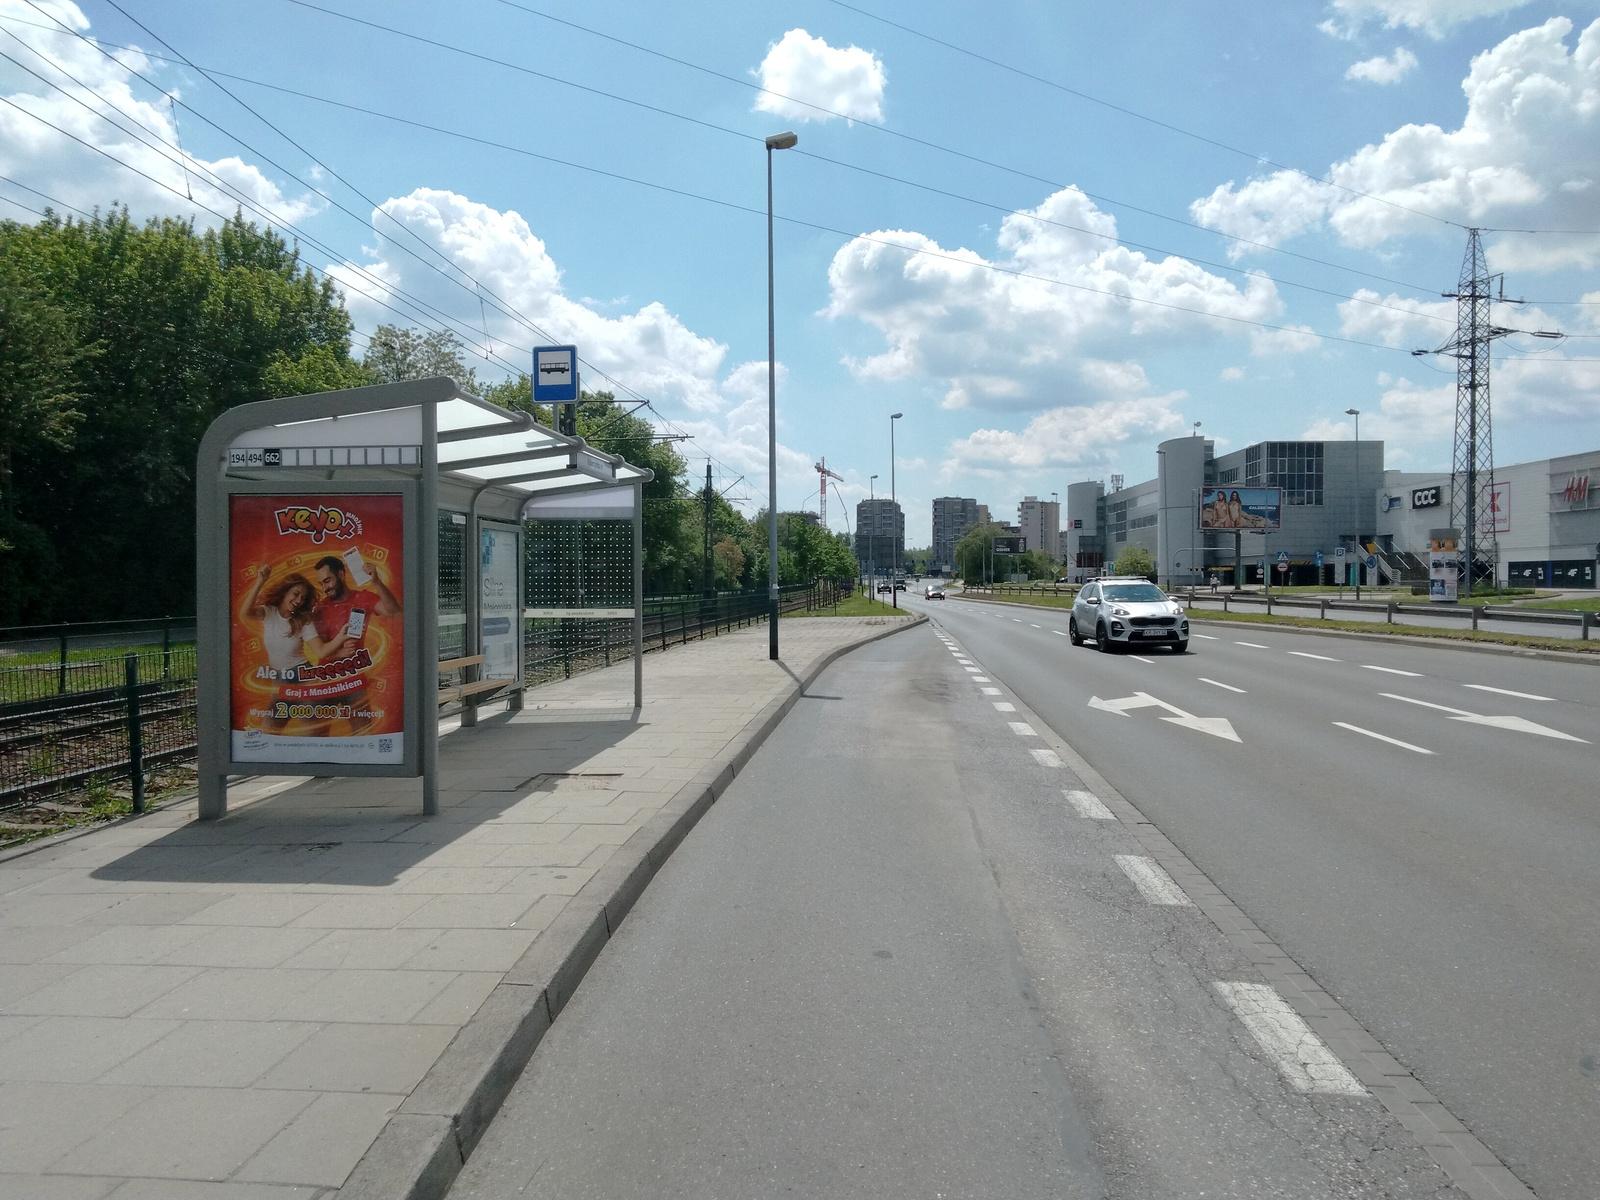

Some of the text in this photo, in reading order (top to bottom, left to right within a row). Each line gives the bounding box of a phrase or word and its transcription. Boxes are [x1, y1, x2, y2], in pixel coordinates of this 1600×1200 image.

[231, 452, 280, 463] 194 494 662
[1414, 489, 1436, 505] CCC
[256, 665, 277, 680] Ale
[280, 668, 295, 680] to
[285, 688, 302, 698] Graj
[309, 679, 363, 697] Mnożnikiem
[275, 702, 288, 718] 2
[289, 704, 314, 718] 000
[315, 704, 338, 718] 000
[339, 705, 351, 718] zł
